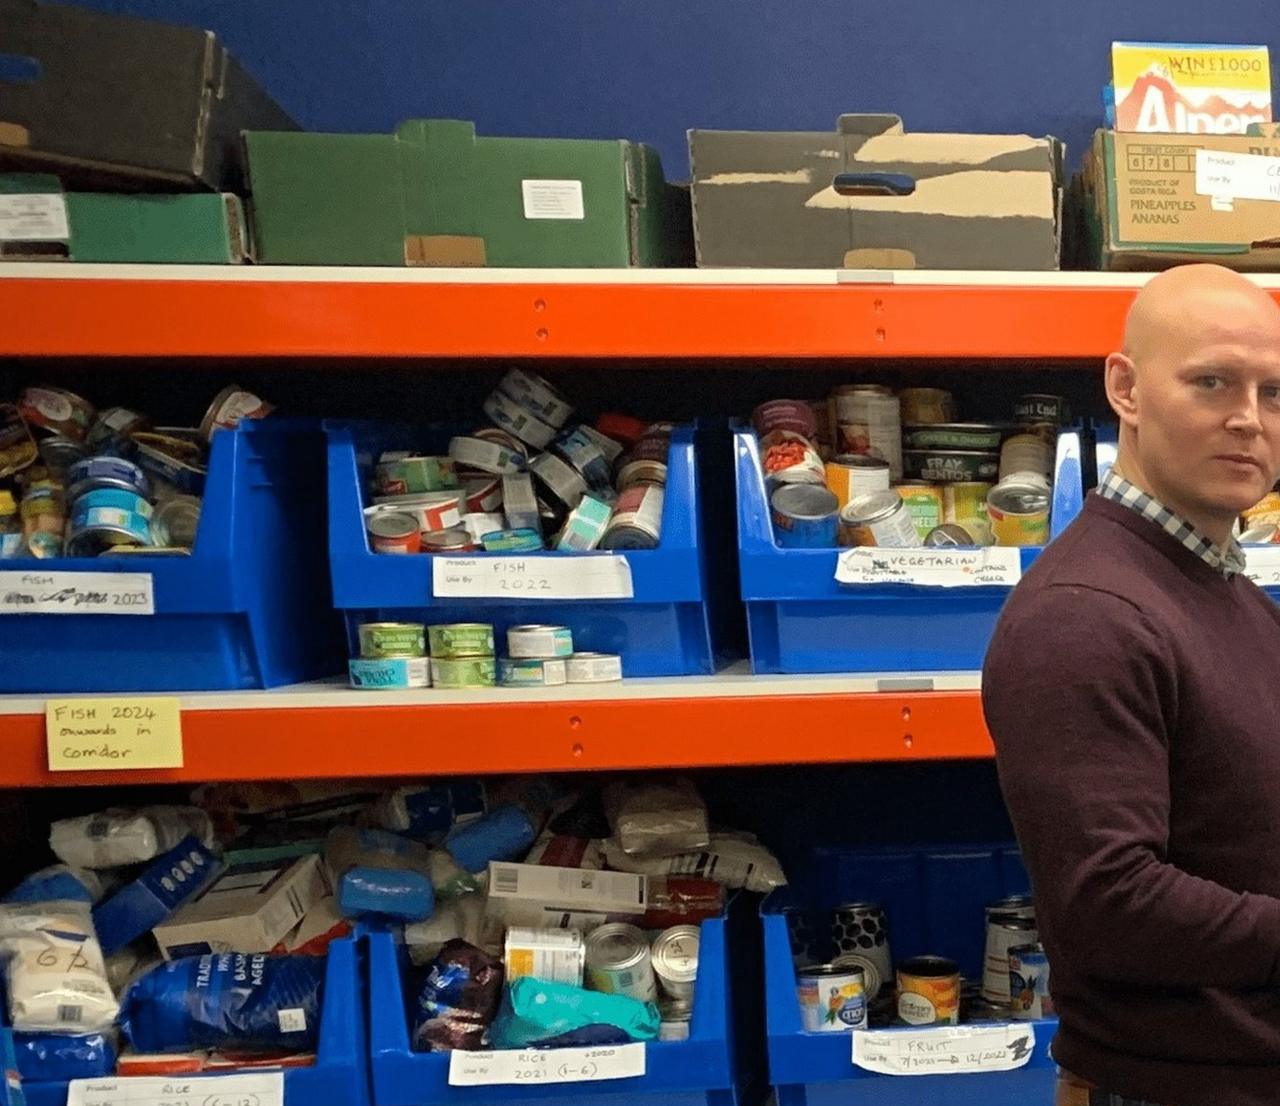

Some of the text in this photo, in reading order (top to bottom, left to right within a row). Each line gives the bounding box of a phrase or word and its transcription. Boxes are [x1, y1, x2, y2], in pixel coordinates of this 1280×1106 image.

[1169, 56, 1263, 73] WIN £1000
[1147, 158, 1154, 168] 7
[1130, 199, 1197, 212] PINEAPPLES
[1131, 213, 1180, 225] ANANAS
[926, 457, 963, 469] FRAY
[920, 469, 973, 482] BENTOS
[492, 562, 526, 573] FISH
[890, 556, 978, 567] VEGETARIAN
[499, 579, 553, 590] 2022
[112, 593, 149, 606] 2023
[54, 705, 157, 723] FISH 2024
[59, 723, 152, 737] onwards in
[62, 743, 133, 760] corridor
[907, 1041, 953, 1053] FRUIT
[517, 1053, 547, 1063] RICE
[513, 1069, 548, 1080] 2021
[161, 1084, 191, 1095] RICE
